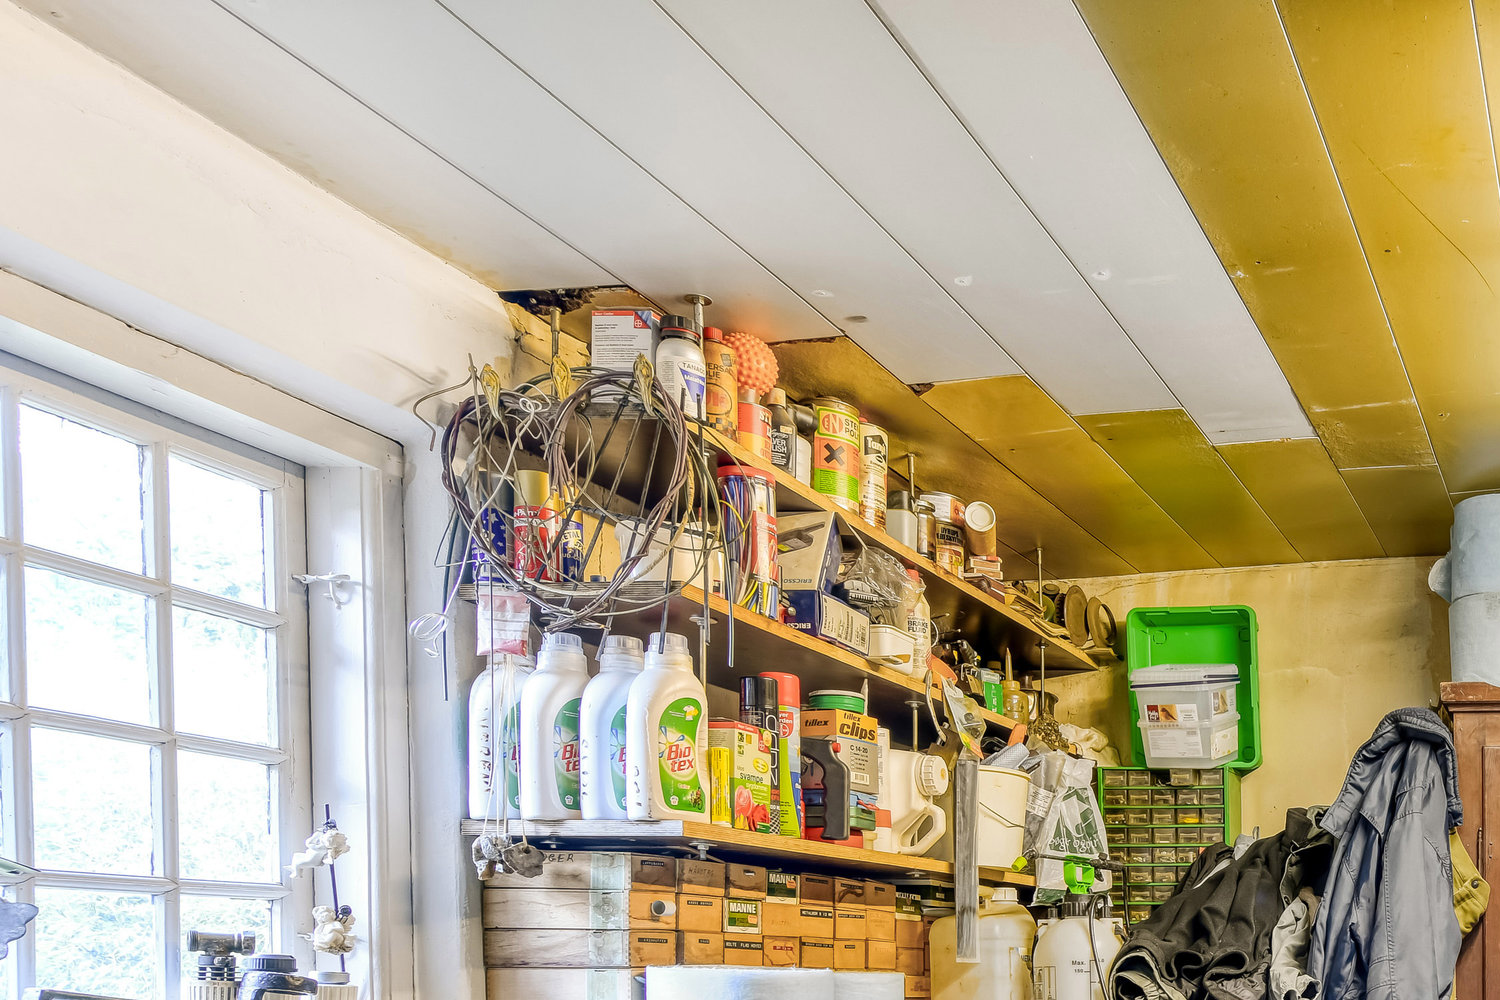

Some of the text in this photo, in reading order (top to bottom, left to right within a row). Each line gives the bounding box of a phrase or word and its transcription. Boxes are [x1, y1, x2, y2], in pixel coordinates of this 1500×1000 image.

[772, 437, 786, 447] VER
[772, 444, 787, 453] LISH
[785, 622, 811, 630] ERICSS
[907, 620, 928, 628] BRAKE
[805, 718, 829, 727] tillex
[843, 712, 861, 723] tillex
[839, 721, 876, 741] clips
[562, 743, 580, 761] Bi
[667, 743, 691, 761] Bio
[670, 758, 694, 772] tex
[740, 772, 763, 784] svampe
[729, 902, 756, 913] MANNE
